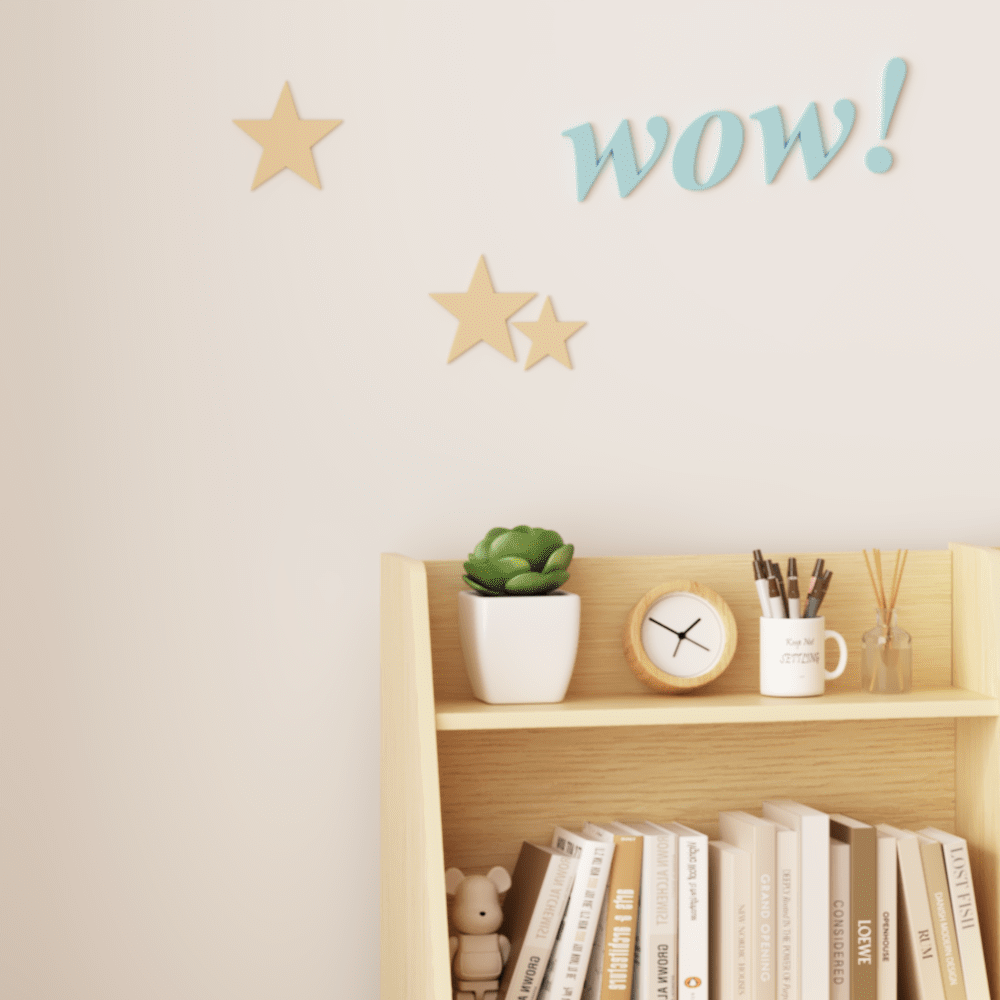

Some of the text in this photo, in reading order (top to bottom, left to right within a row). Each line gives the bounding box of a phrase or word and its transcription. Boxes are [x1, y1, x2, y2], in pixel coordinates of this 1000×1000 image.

[560, 56, 909, 203] wow!
[760, 873, 771, 983] GRAND OPENING
[949, 846, 976, 930] LOST FISH
[833, 899, 845, 986] CONSIDERED
[857, 919, 872, 966] LOEWE
[882, 911, 890, 962] OPENHOUSE
[918, 929, 933, 960] RUM
[934, 891, 958, 986] DANISH MODERN DESIGN
